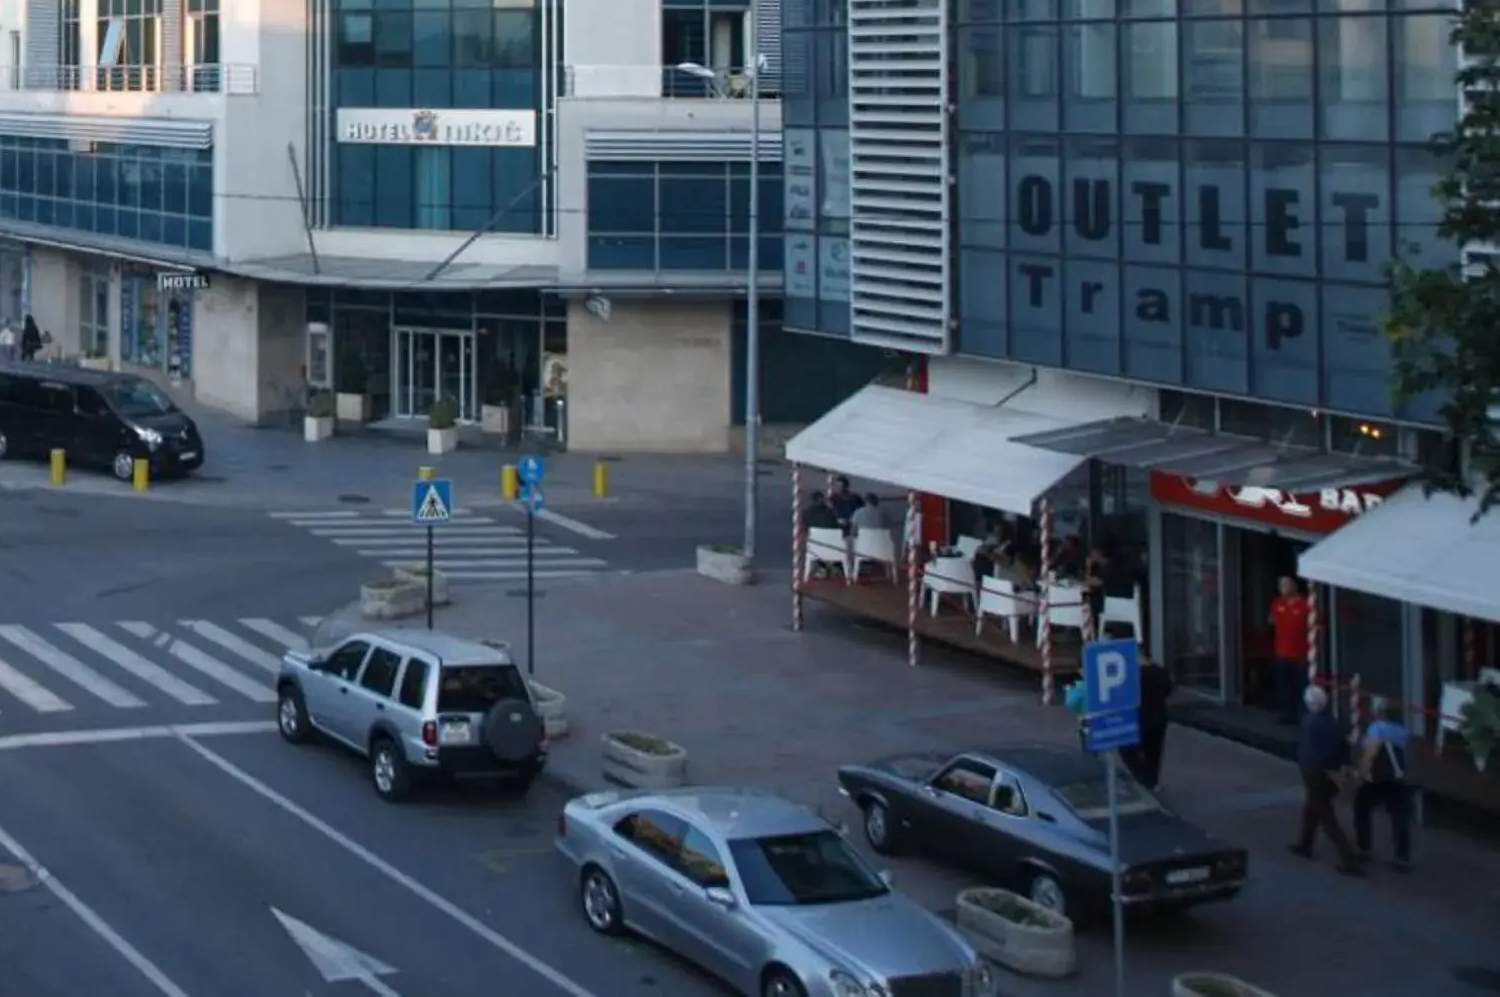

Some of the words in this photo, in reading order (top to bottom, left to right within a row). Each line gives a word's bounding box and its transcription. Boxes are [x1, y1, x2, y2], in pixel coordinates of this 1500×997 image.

[349, 122, 410, 140] HOTEL
[1017, 174, 1380, 263] OUTLET
[163, 275, 209, 289] HOTEL
[1018, 263, 1306, 350] Tramp
[1096, 651, 1127, 703] P
